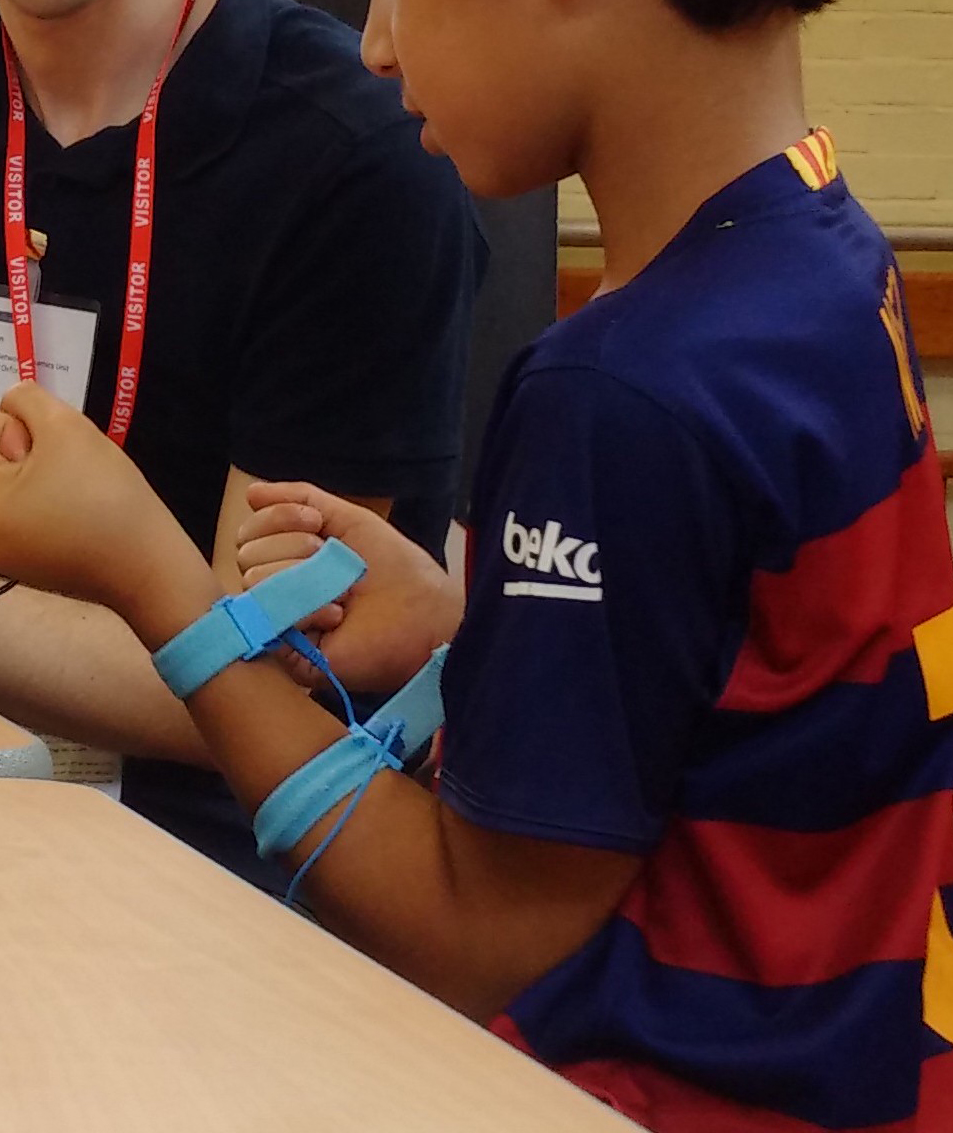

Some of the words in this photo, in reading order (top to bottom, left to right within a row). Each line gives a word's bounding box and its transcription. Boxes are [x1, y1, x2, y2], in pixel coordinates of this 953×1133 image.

[7, 155, 23, 223] VISITOR
[133, 157, 151, 228] VISITOR
[8, 256, 29, 326] VISITOR
[126, 261, 147, 333] VISITOR
[111, 366, 136, 435] VISITOR
